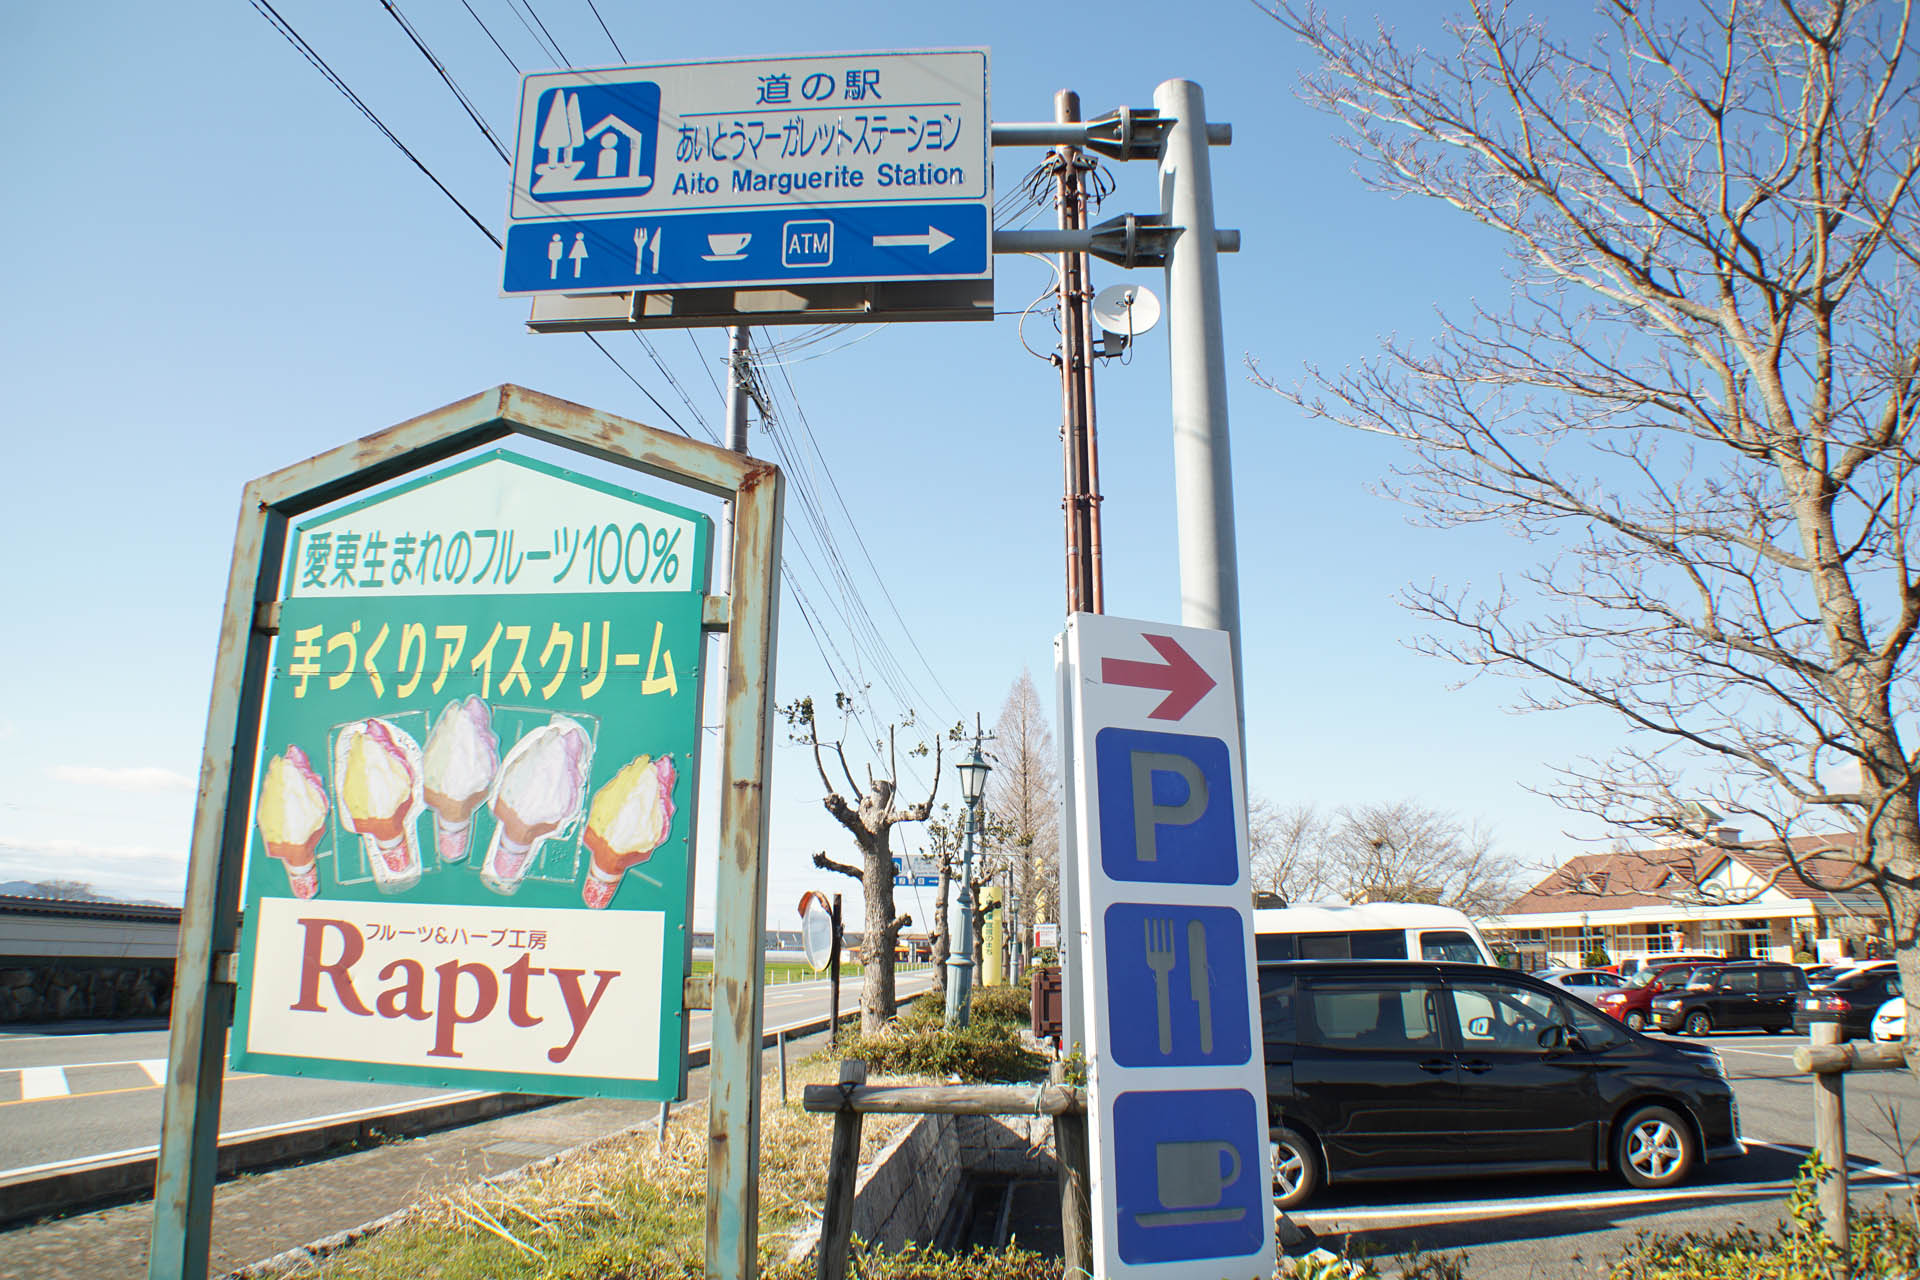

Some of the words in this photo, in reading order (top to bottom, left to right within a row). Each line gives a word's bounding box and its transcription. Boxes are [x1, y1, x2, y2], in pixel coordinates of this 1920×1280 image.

[756, 70, 881, 104] 道の駅
[675, 115, 961, 163] あいとうマーガレットステーション
[673, 172, 719, 195] Aito
[732, 166, 864, 193] Marguerite
[877, 163, 964, 185] Station
[788, 232, 828, 254] ATM
[302, 522, 681, 588] 愛東生まれのフルーツ100%
[289, 621, 678, 700] 手づくりアイスクリーム
[1130, 751, 1209, 861] P
[289, 918, 621, 1063] Rapty
